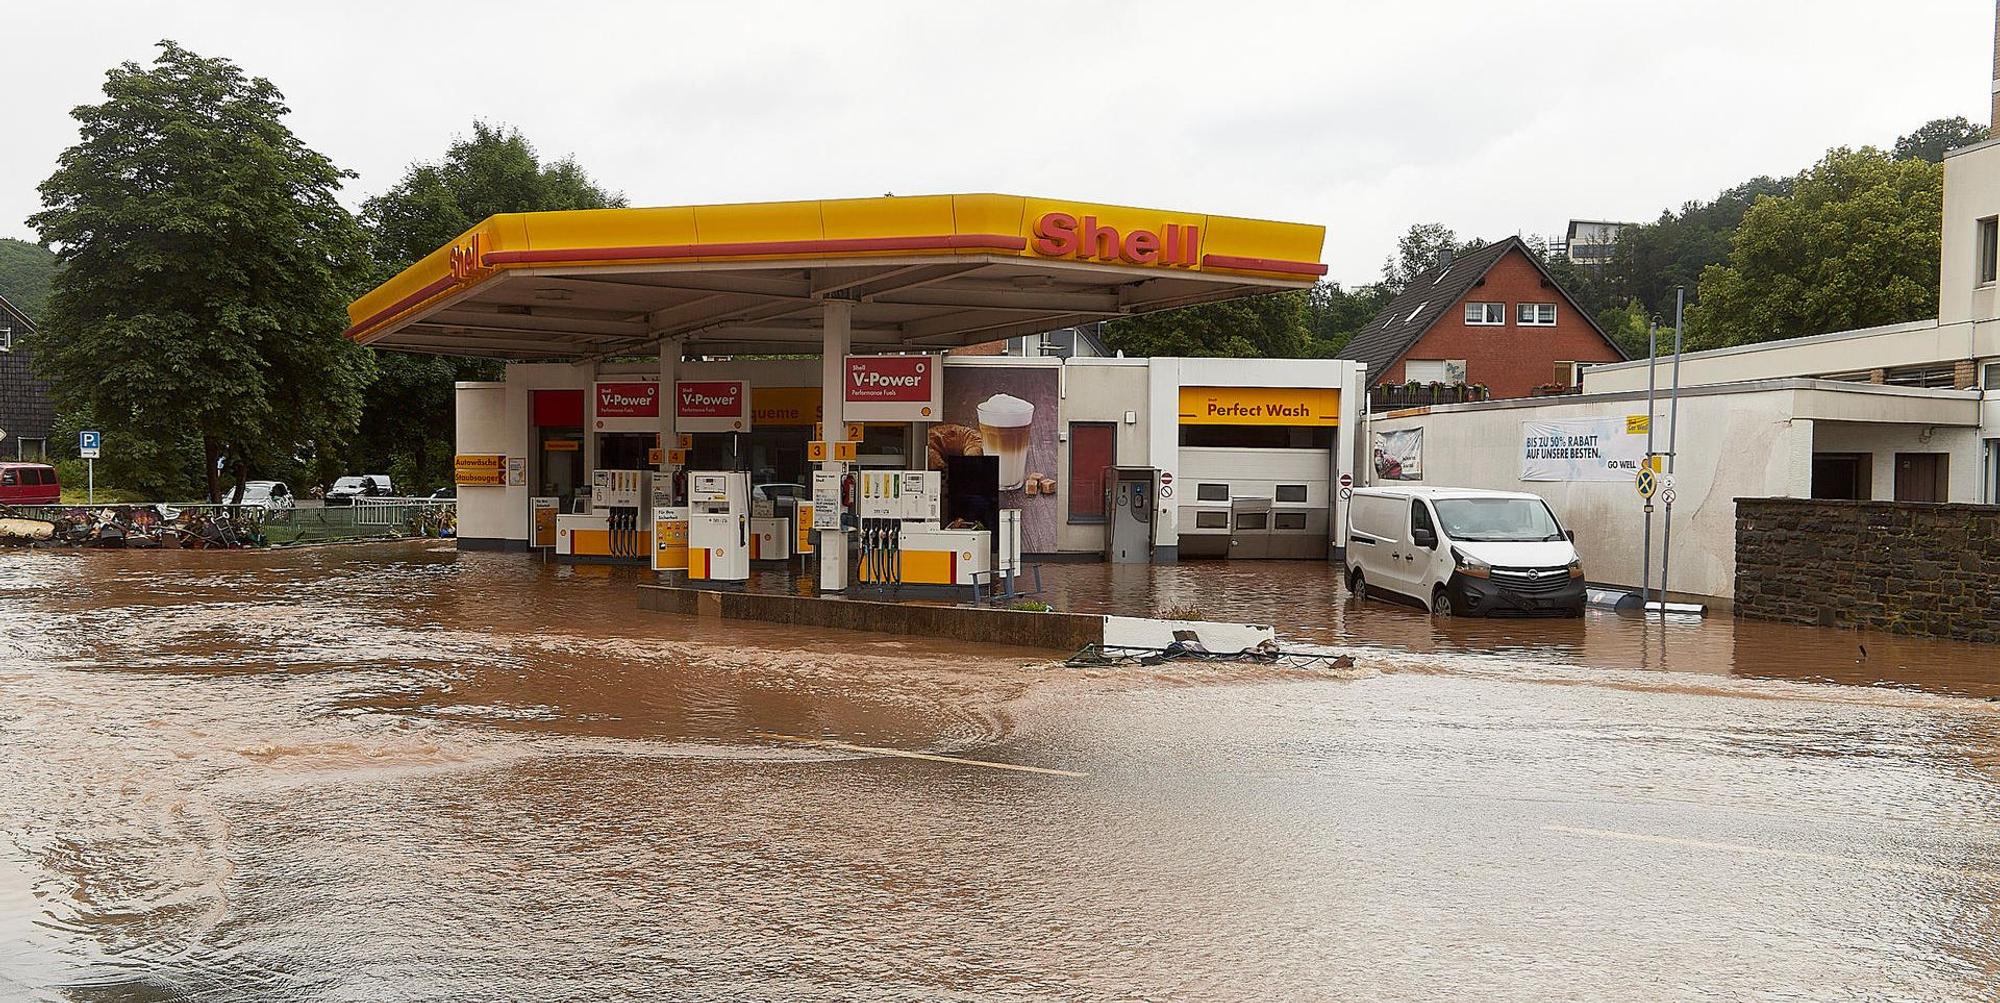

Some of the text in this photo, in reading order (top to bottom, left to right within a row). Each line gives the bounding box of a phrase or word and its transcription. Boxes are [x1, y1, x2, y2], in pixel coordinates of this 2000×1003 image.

[1031, 212, 1199, 268] Shell
[852, 372, 921, 387] V-Power
[602, 394, 652, 406] V-Power
[683, 393, 735, 405] V-Power
[1207, 402, 1310, 417] Perfect Wash
[851, 426, 858, 437] 2
[83, 433, 94, 447] P
[682, 437, 688, 446] 5
[1526, 435, 1598, 448] BIS ZU 50% RABATT
[653, 451, 659, 460] 6
[671, 452, 678, 460] 4
[814, 445, 821, 456] 3
[841, 445, 846, 457] 1
[1526, 447, 1601, 459] AUF UNSERE BESTEN.
[456, 458, 497, 466] Autowäsche
[1607, 460, 1636, 469] GO WELL
[456, 473, 498, 484] Staubsauger
[596, 492, 603, 502] 6
